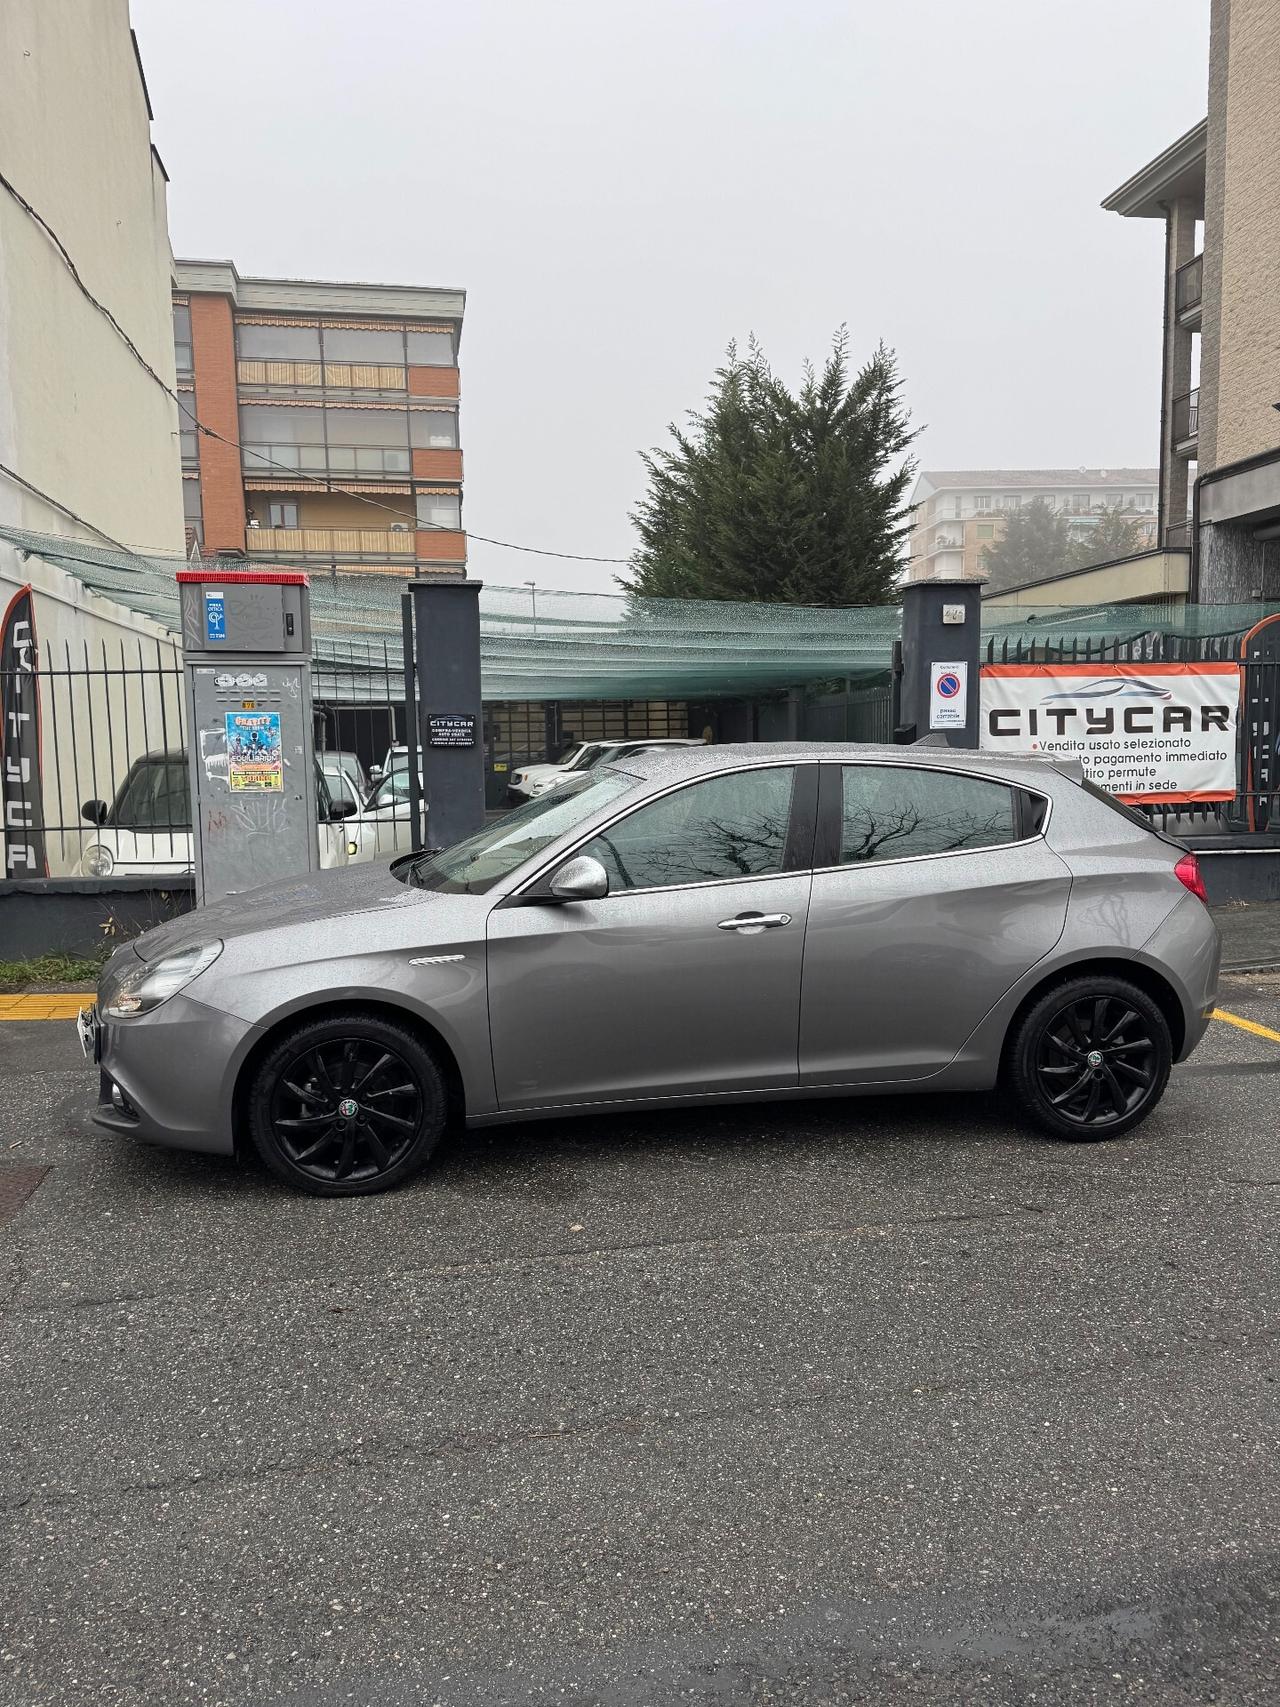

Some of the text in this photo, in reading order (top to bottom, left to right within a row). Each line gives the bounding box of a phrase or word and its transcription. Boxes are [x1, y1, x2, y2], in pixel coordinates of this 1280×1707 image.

[989, 705, 1230, 736] CITYCAR
[1039, 737, 1192, 751] Vendita usato selezionato
[1093, 752, 1162, 767] pagamento
[1165, 750, 1228, 762] immediato
[1108, 766, 1157, 780] permute
[1135, 780, 1146, 791] in
[1148, 780, 1178, 790] sede
